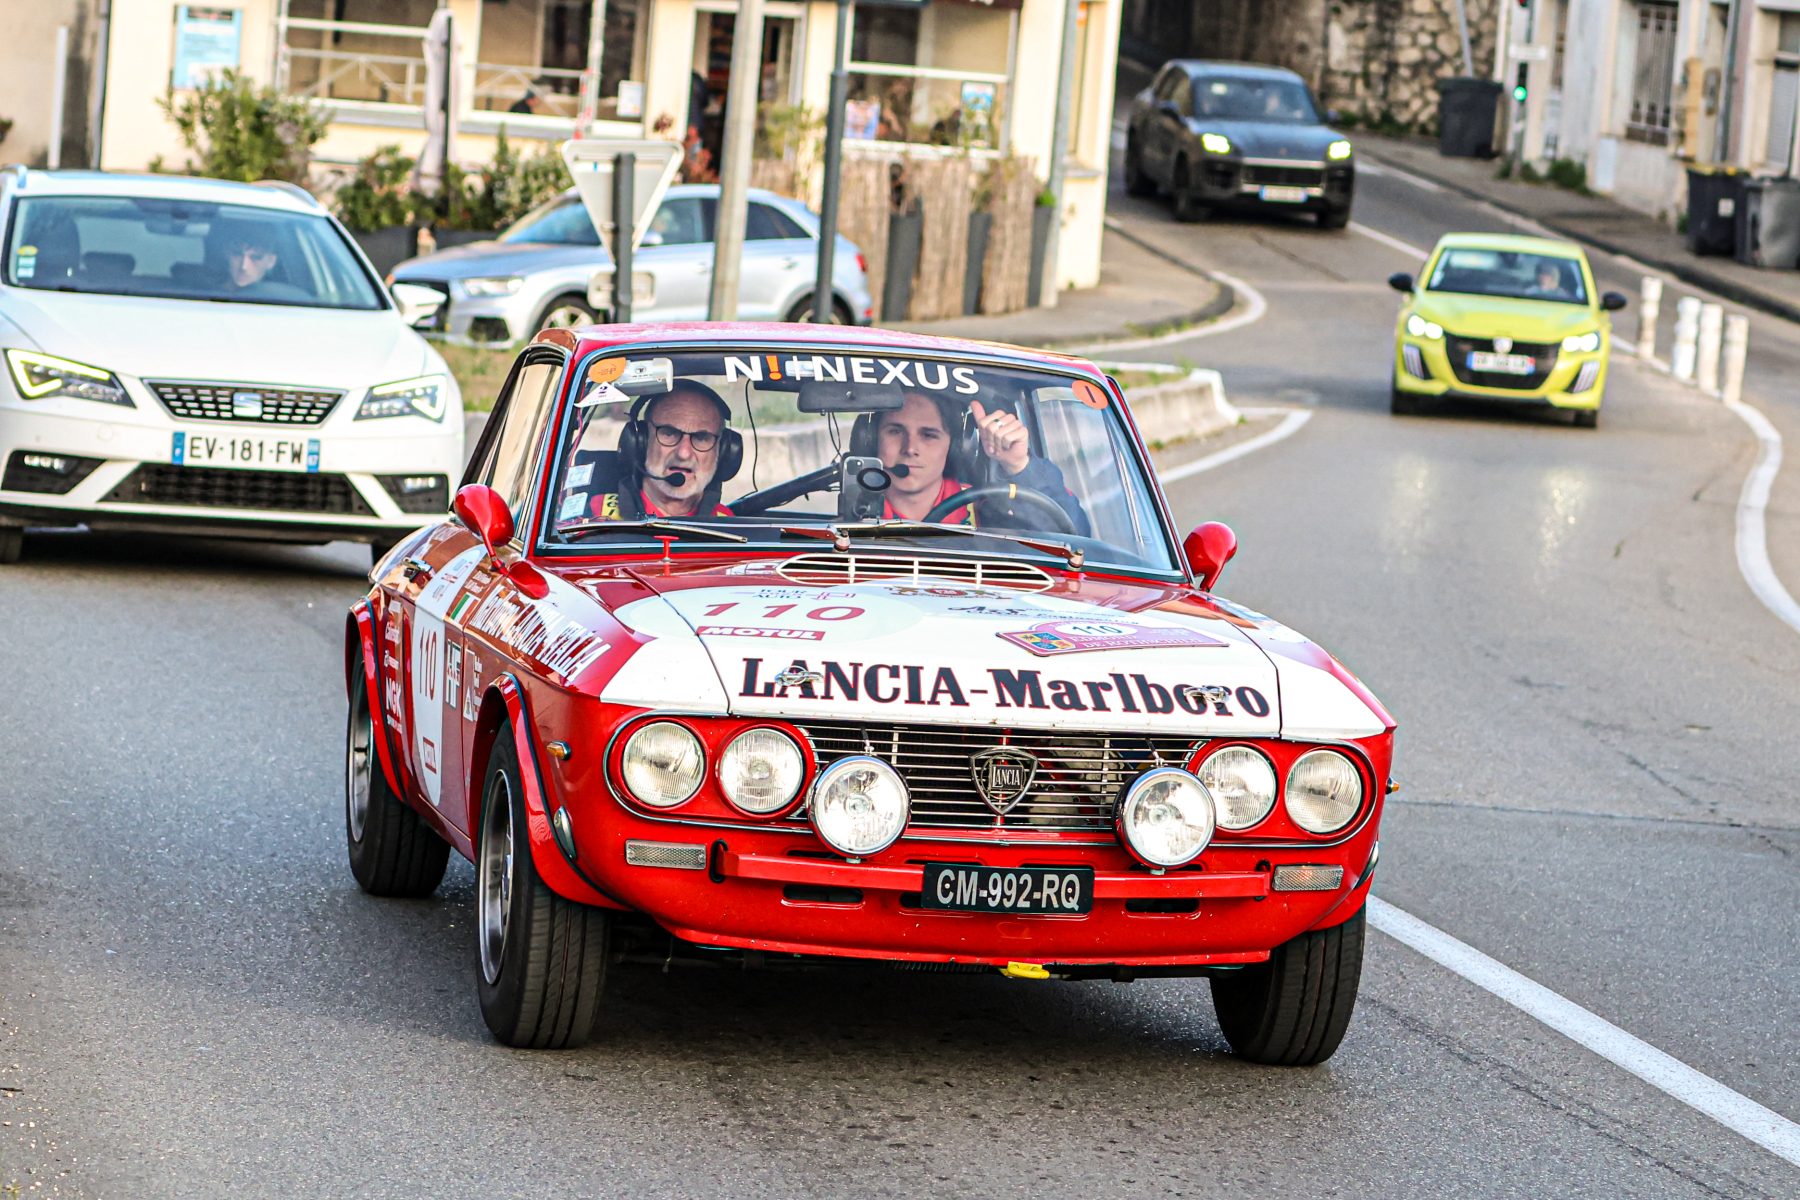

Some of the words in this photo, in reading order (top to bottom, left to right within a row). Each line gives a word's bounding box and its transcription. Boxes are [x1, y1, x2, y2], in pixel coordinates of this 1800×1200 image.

[189, 436, 303, 465] EV-181-FW
[704, 602, 865, 621] 110
[700, 626, 819, 640] MOTUL
[1072, 625, 1122, 635] 110
[420, 627, 437, 701] 110
[386, 676, 402, 719] NGK
[992, 766, 1021, 788] LANCIA
[936, 868, 1080, 911] CM-992-RQ
